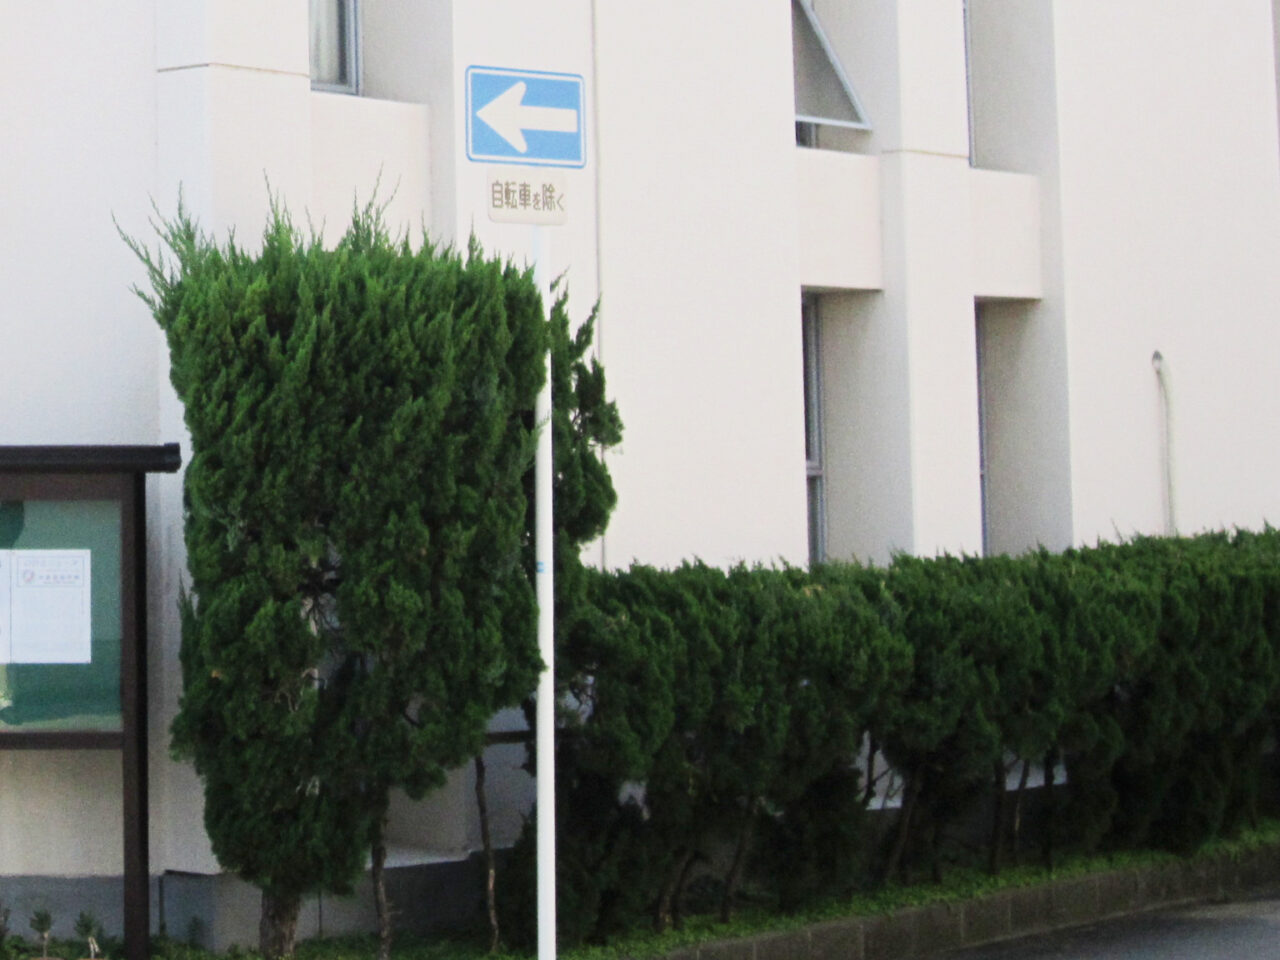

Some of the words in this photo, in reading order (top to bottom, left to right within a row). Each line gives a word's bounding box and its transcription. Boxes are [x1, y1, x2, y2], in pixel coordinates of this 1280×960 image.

[492, 180, 565, 211] 自転車を除く
